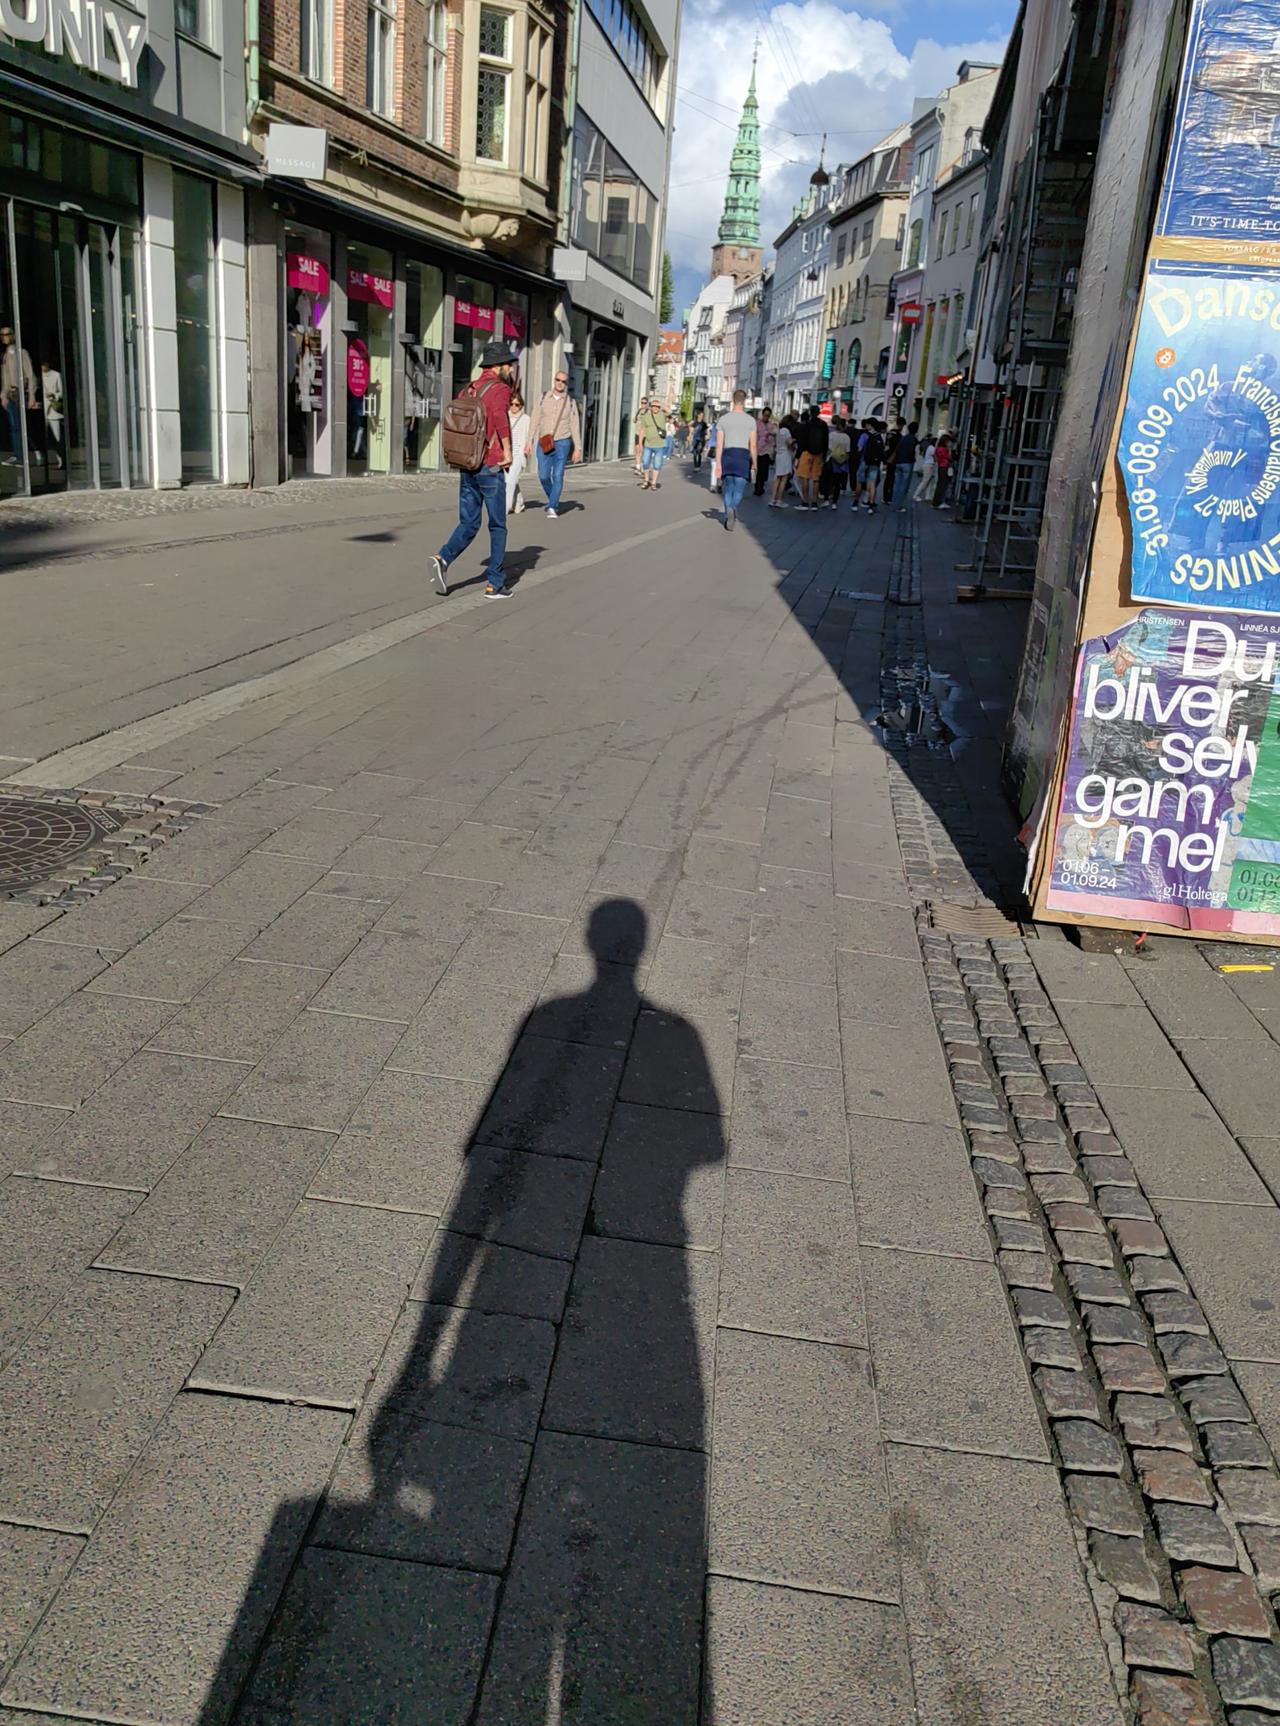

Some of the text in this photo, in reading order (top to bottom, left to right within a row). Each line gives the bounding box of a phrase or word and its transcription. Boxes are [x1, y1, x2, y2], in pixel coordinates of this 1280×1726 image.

[0, 0, 147, 88] ONLY
[275, 157, 316, 169] MESSAGE
[1190, 214, 1218, 228] IT'S
[1223, 217, 1259, 230] TIME
[298, 257, 320, 277] SALE
[350, 271, 368, 287] SALE
[374, 277, 391, 293] SALE
[1163, 364, 1219, 412] 2024
[1184, 448, 1248, 495] København V
[1193, 494, 1219, 517] 27
[1216, 496, 1258, 523] Plads
[1183, 620, 1276, 682] Du
[1084, 664, 1249, 728] bliver
[1074, 775, 1215, 828] gam
[1115, 819, 1228, 873] mel
[1062, 860, 1099, 874] 01.06
[1061, 872, 1117, 889] 01.09.24
